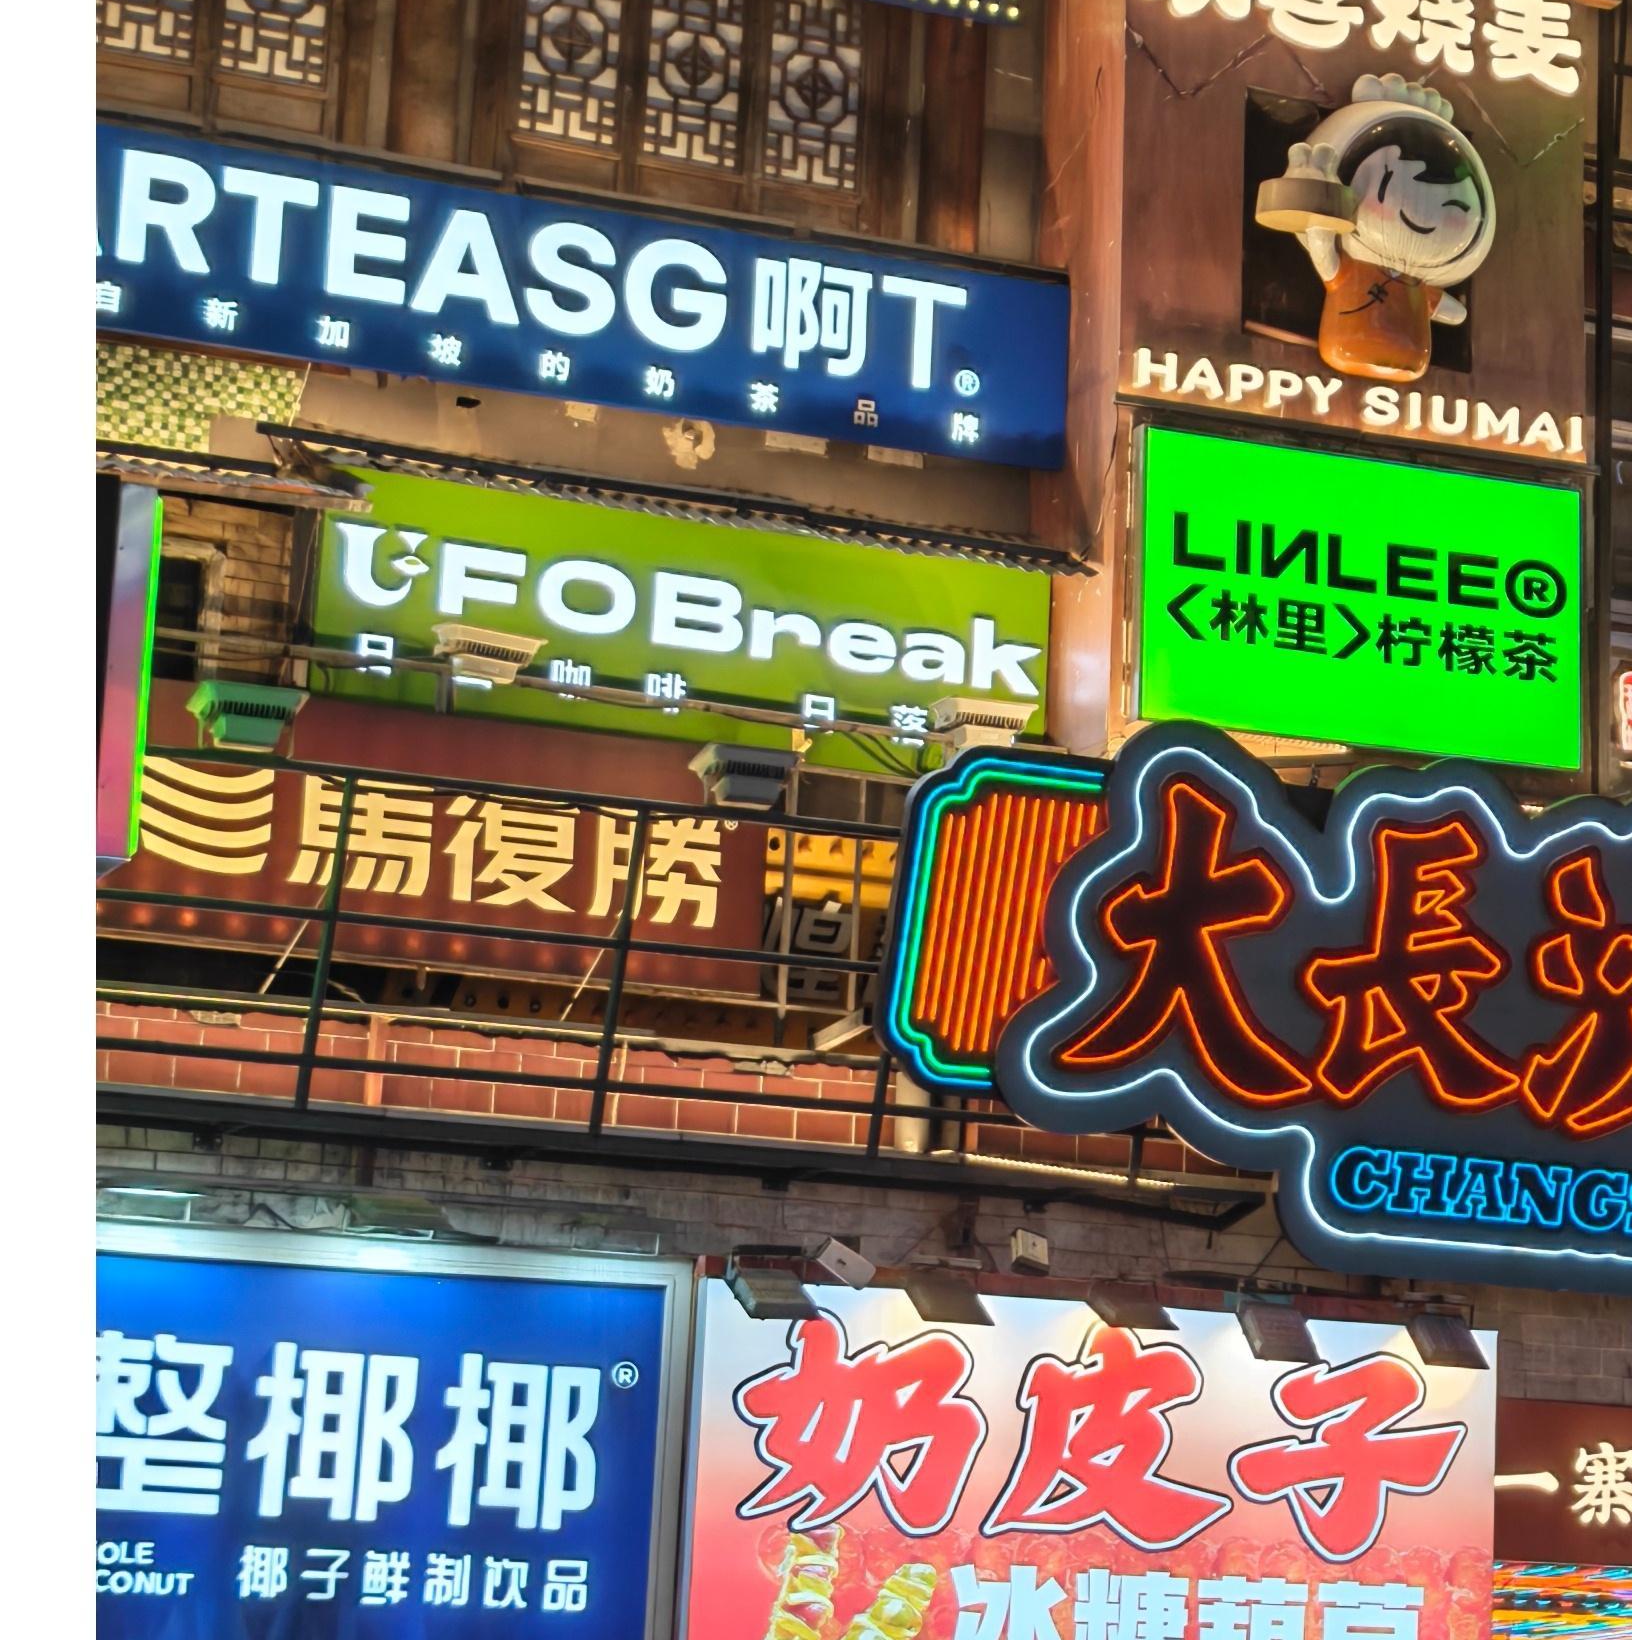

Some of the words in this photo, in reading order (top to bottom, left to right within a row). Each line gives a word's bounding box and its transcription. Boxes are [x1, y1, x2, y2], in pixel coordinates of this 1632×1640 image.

[95, 147, 729, 352] RTEASG
[1131, 346, 1343, 414] HAPPY
[1361, 384, 1585, 454] SIUMAI
[734, 1306, 1467, 1565] 奶皮子
[95, 1540, 155, 1565] OLE
[237, 1544, 589, 1613] 椰子鲜制饮品
